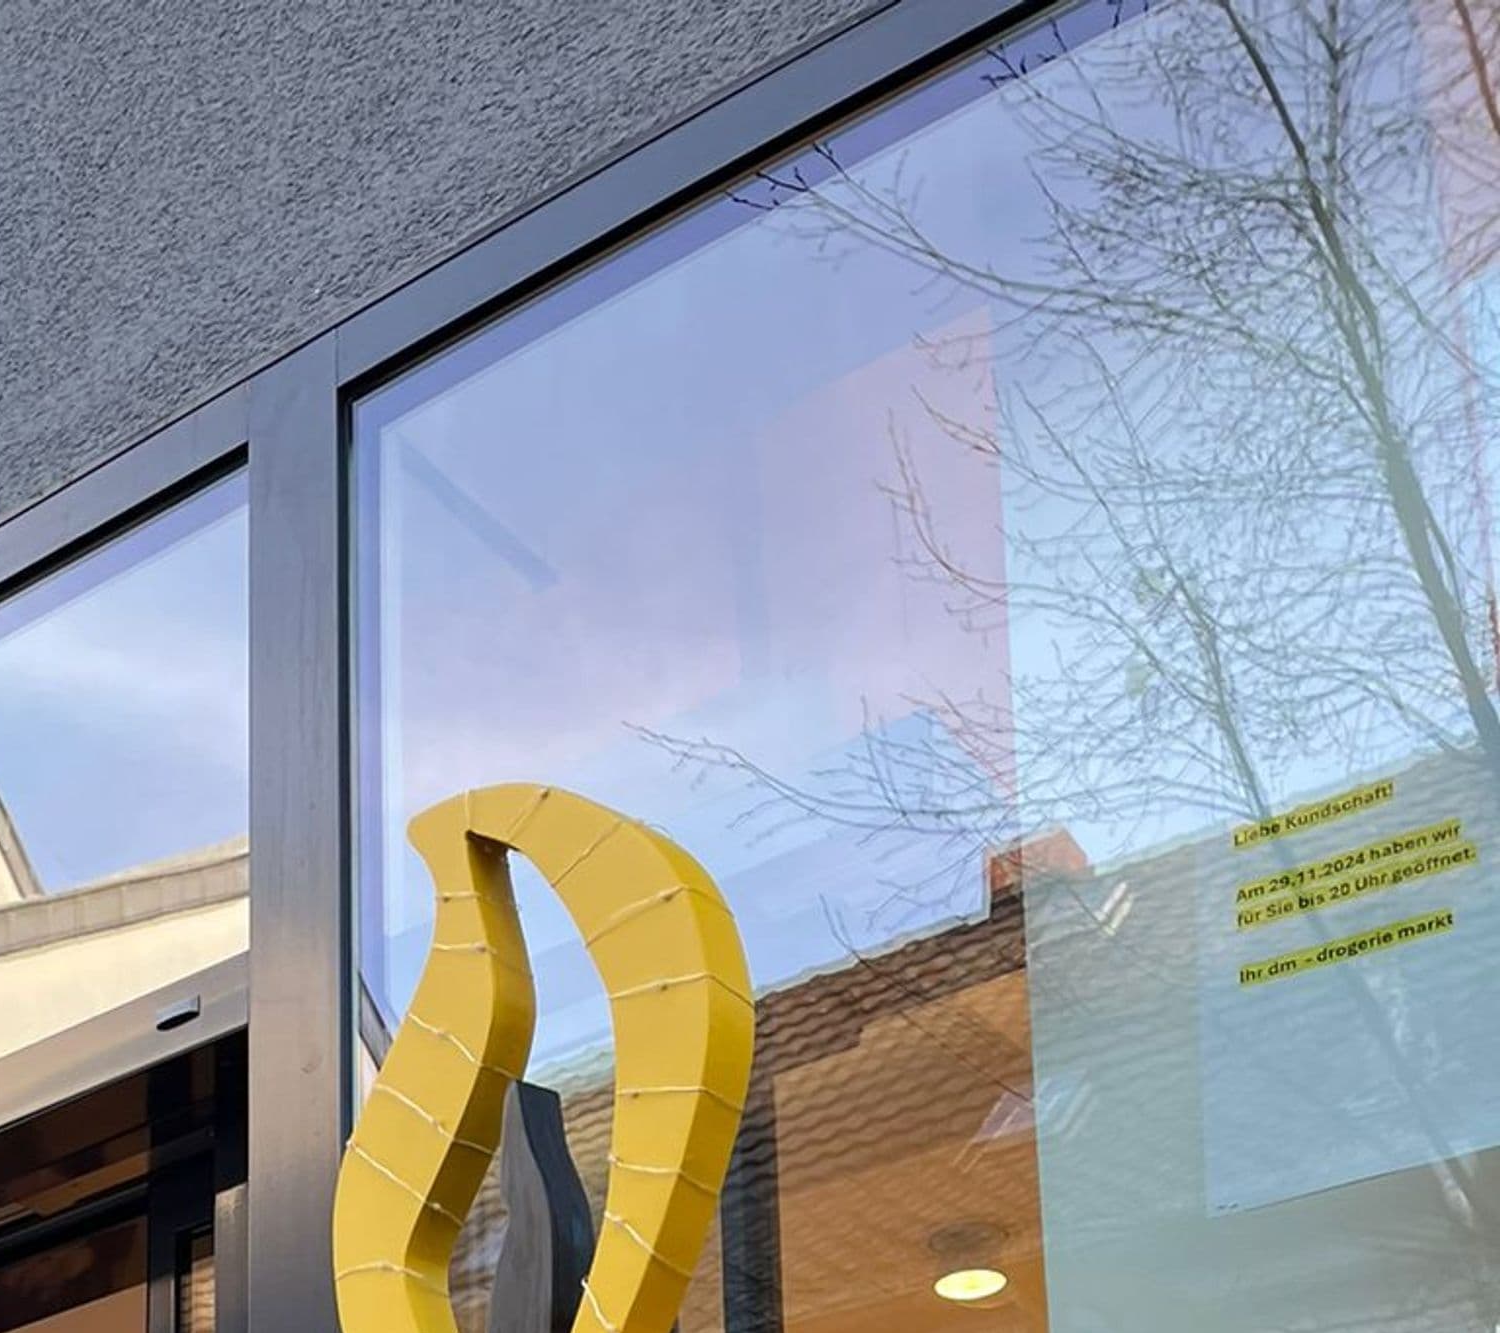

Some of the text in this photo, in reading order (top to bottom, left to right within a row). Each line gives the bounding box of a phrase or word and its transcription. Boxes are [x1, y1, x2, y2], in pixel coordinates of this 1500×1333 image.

[1234, 783, 1393, 846] Liebe Kundschaft!
[1236, 886, 1265, 902] Am
[1369, 835, 1427, 861] haben
[1431, 825, 1460, 842] wir
[1237, 909, 1261, 926] für
[1266, 902, 1293, 918] Sie
[1298, 894, 1325, 910] bis
[1330, 883, 1350, 901] 20
[1355, 872, 1388, 891] Uhr
[1239, 968, 1264, 984] Ihr
[1268, 960, 1297, 977] dm
[1316, 932, 1393, 963] drogerie
[1397, 913, 1454, 939] markt
